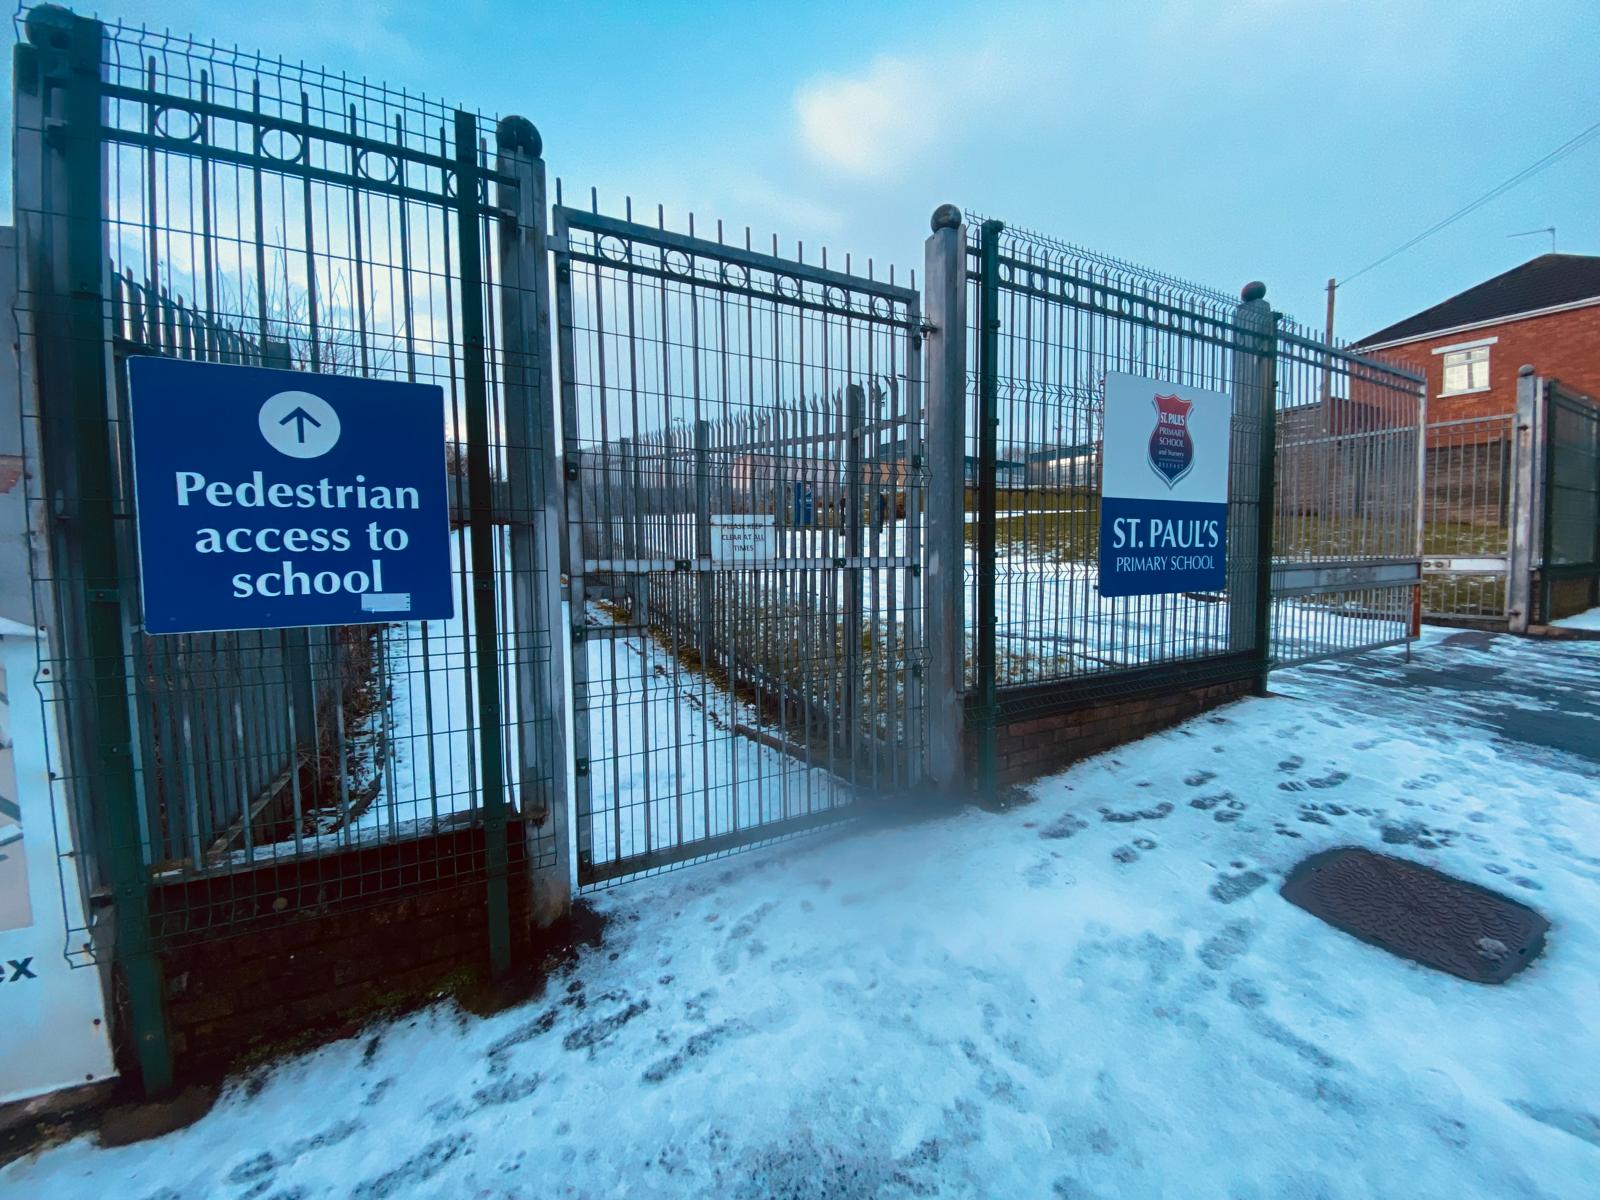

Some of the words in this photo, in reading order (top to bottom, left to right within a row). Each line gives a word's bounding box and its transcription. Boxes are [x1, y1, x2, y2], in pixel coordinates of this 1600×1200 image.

[1159, 427, 1185, 437] PRIMARY
[1159, 437, 1185, 447] SCHOOL
[176, 471, 419, 509] Pedestrian
[195, 527, 350, 553] access
[366, 521, 409, 551] to
[1113, 518, 1144, 549] ST.
[1150, 519, 1219, 548] PAUL'S
[1116, 556, 1168, 572] PRIMARY
[1171, 555, 1215, 571] SCHOOL
[232, 559, 383, 598] school
[0, 956, 38, 983] x
